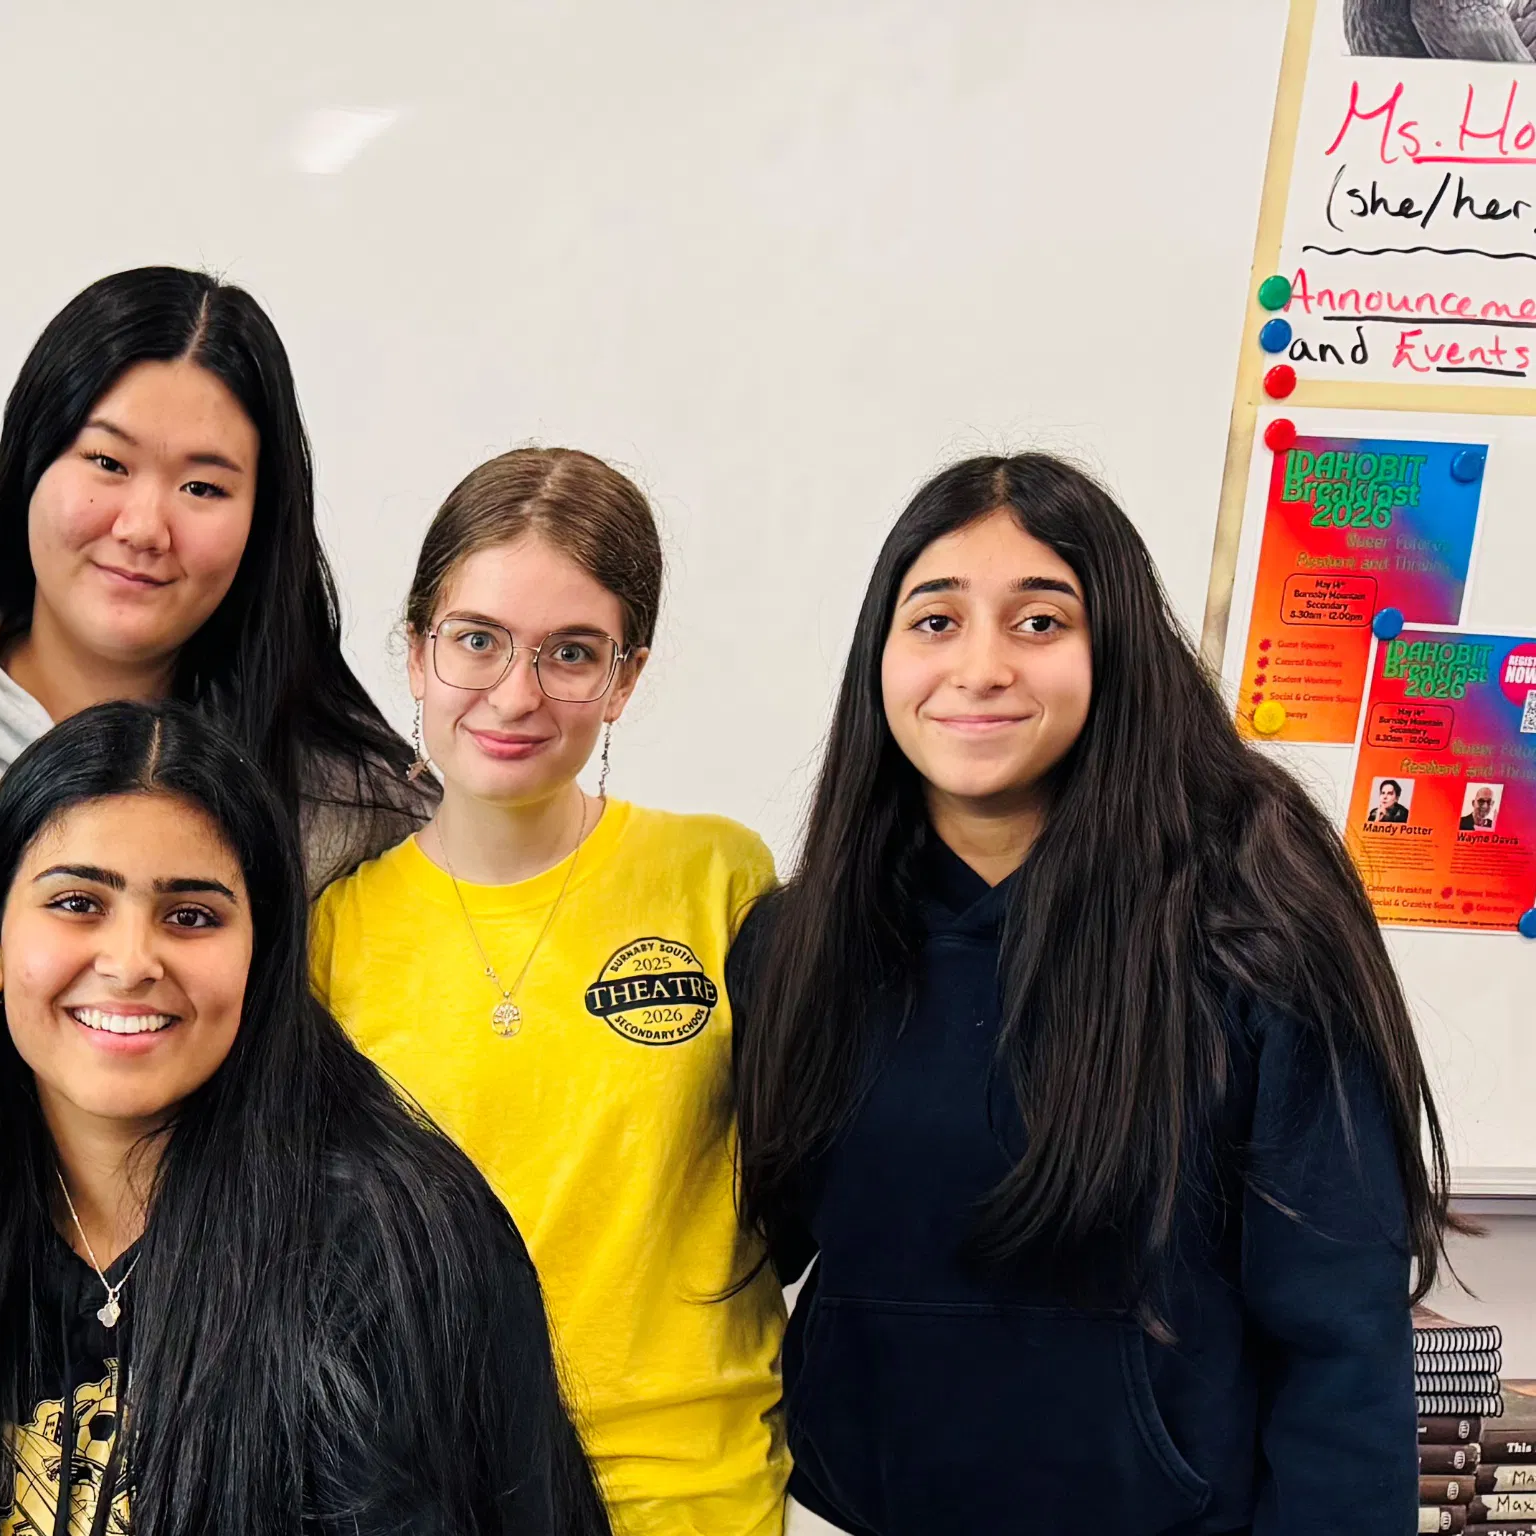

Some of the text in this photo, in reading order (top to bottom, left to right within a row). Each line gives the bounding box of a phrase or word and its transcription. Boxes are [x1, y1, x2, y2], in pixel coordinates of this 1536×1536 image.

[1324, 80, 1442, 164] Ms.
[1325, 163, 1536, 234] (she/her
[1288, 326, 1531, 373] and Events
[1286, 449, 1428, 484] IDAHOBIT
[1282, 475, 1421, 508] Breakfast
[1311, 502, 1393, 529] 2026
[1387, 640, 1494, 668] IDAHOBIT
[1383, 657, 1489, 685] Breakfast
[1404, 678, 1466, 699] 2026
[1362, 822, 1433, 836] Mandy Potter
[1457, 831, 1490, 845] Wayne
[632, 956, 672, 971] 2025
[659, 943, 693, 965] SOUTH
[587, 977, 716, 1010] THEATRE
[614, 1008, 705, 1039] SECONDARY SCHOOL
[643, 1008, 683, 1025] 2026
[1506, 1442, 1532, 1453] This
[1512, 1470, 1536, 1487] MA
[1496, 1494, 1535, 1513] Max
